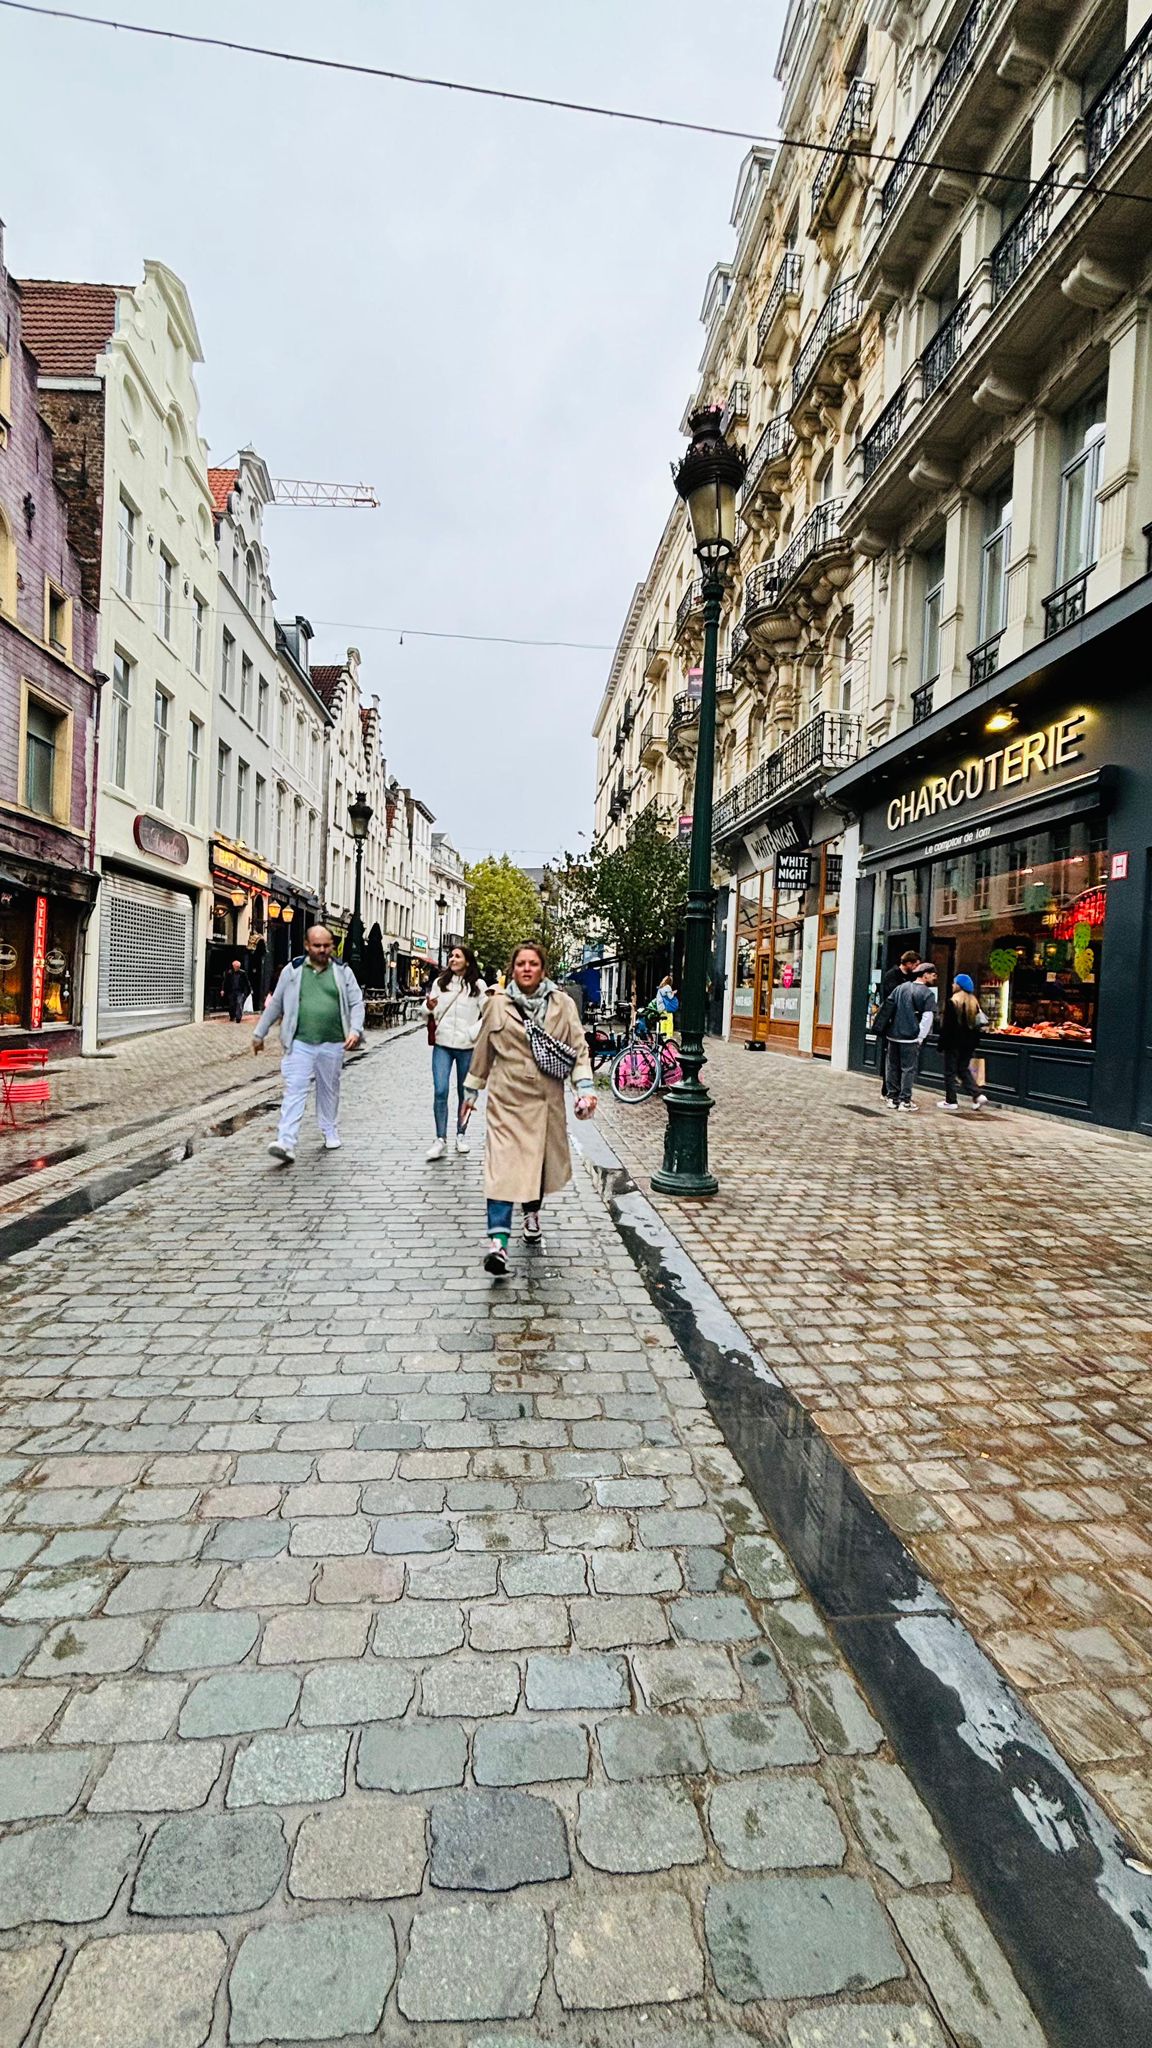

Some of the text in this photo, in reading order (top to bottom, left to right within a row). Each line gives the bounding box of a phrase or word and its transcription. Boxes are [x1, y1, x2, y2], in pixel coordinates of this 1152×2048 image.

[887, 715, 1083, 831] CHARCUTERIE
[751, 821, 800, 858] WHITE NIGHT
[924, 826, 992, 855] Le comptoir de Tom
[778, 869, 807, 880] NIGHT
[779, 856, 808, 867] WHITE
[33, 898, 45, 1027] STELLA ARTOIS
